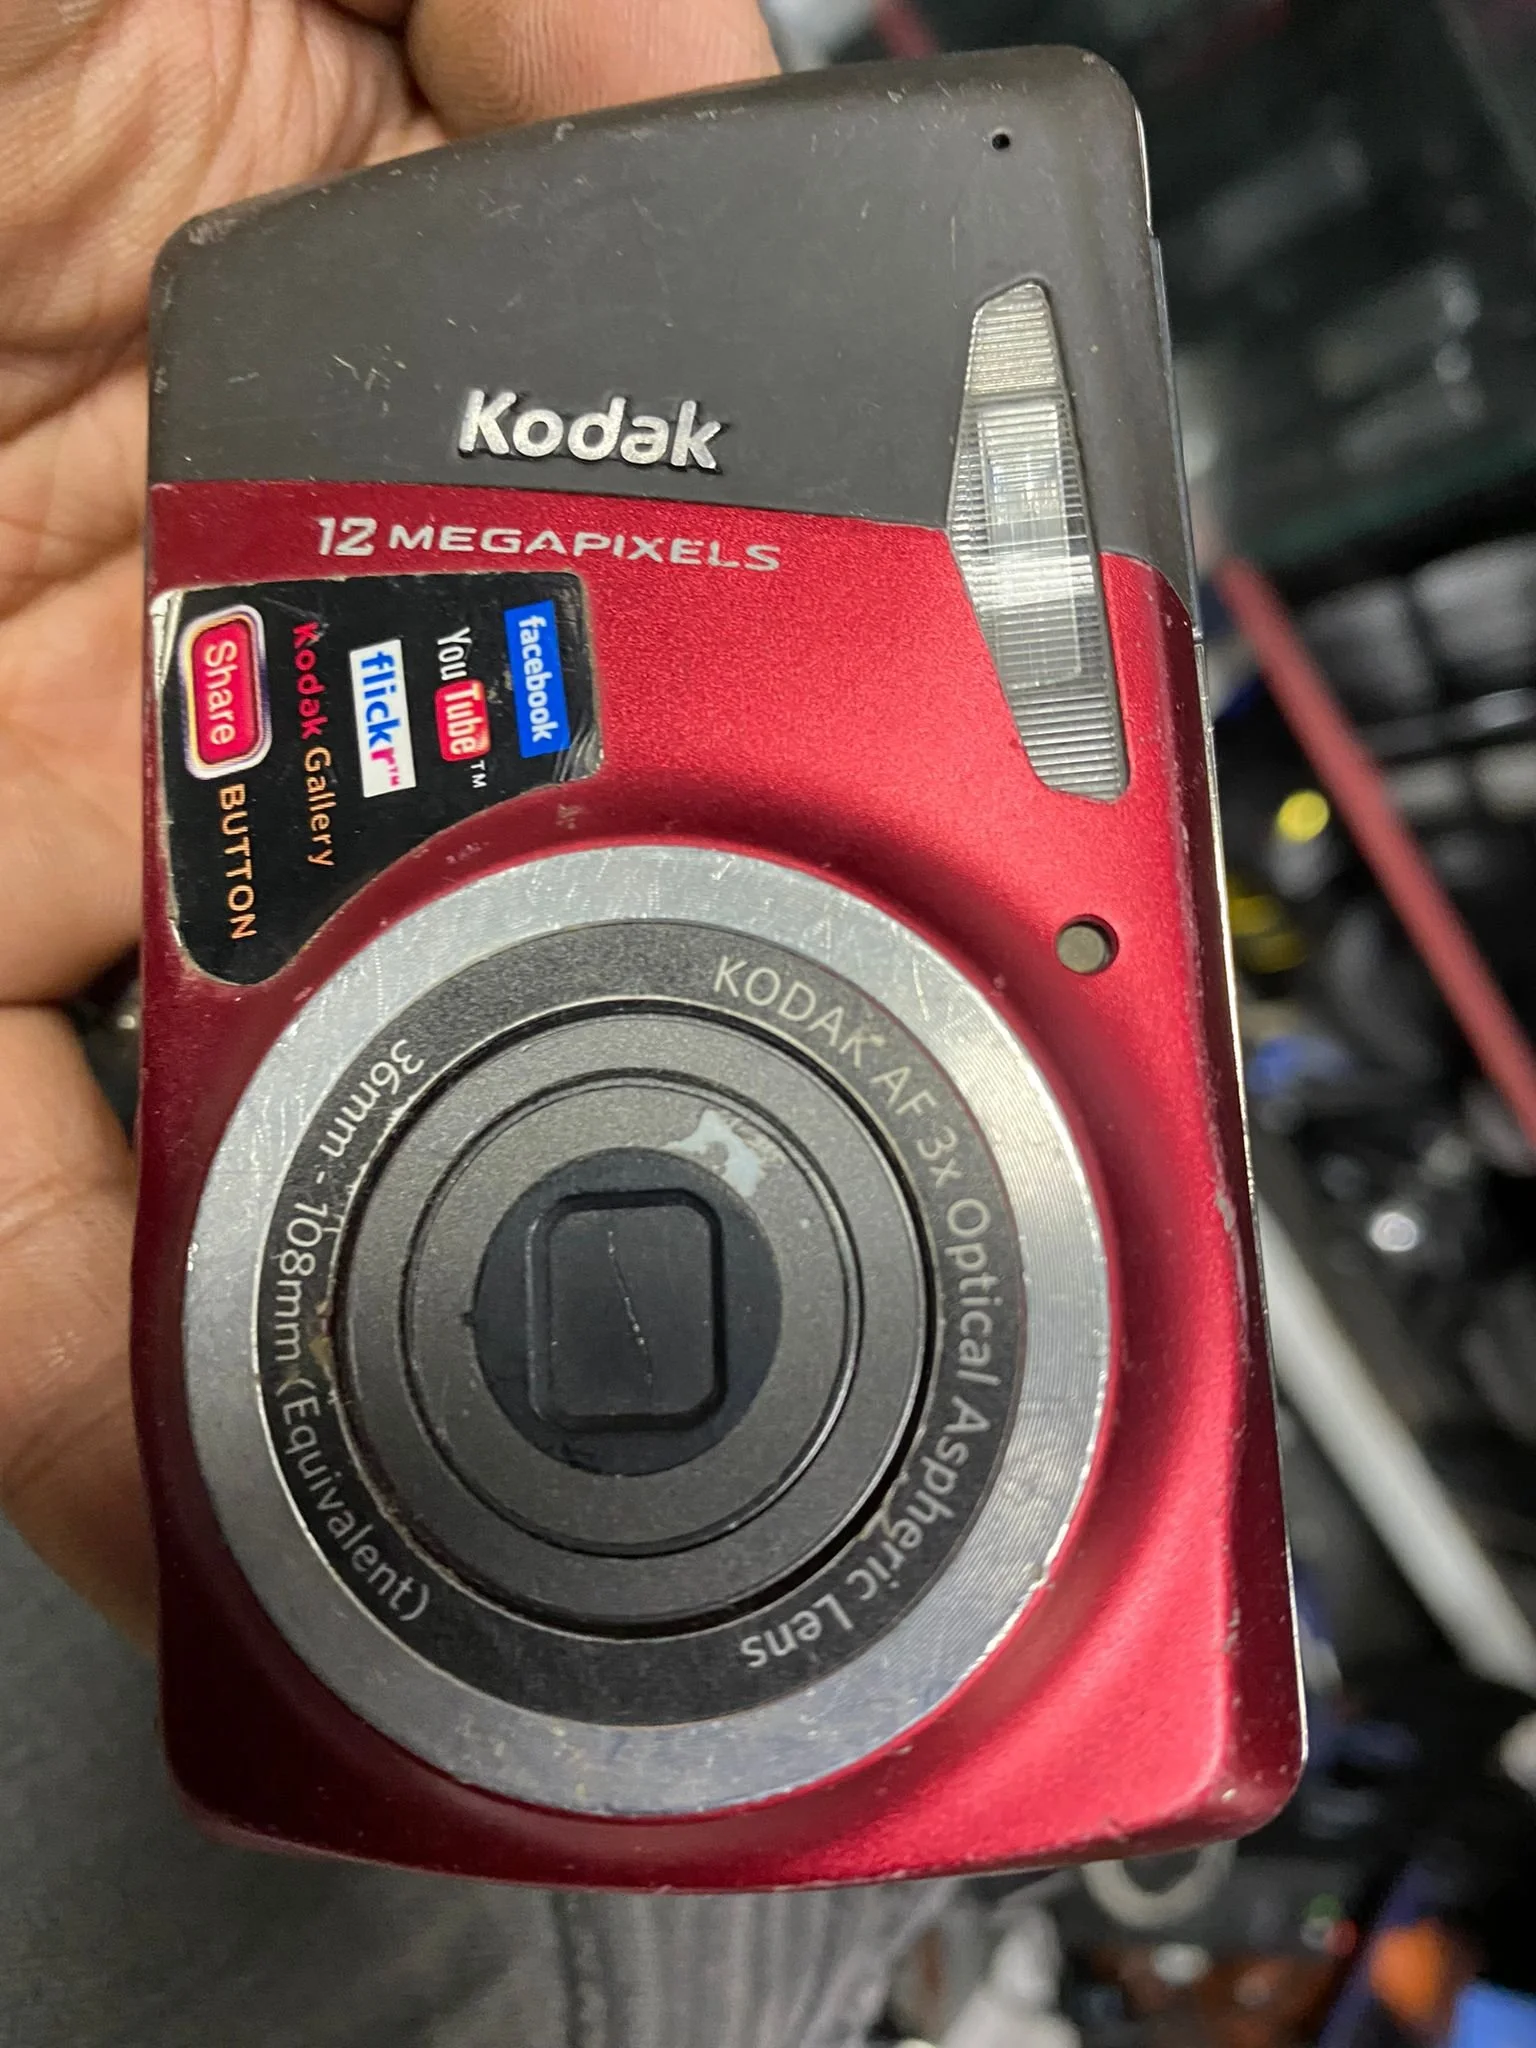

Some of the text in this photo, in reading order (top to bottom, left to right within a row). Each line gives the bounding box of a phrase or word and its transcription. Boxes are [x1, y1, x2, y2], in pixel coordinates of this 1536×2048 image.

[460, 388, 723, 469] Kodak
[317, 517, 780, 572] 12 MEGAPIXELS
[292, 622, 336, 867] Kodak Gallery
[518, 615, 559, 743] facebook
[204, 639, 257, 938] Share BUTTON
[320, 1039, 423, 1159] 36mm
[276, 1202, 328, 1362] 108mm
[714, 955, 1002, 1667] KODAK AF 3x Optical Aspheric Lens
[276, 1378, 429, 1622] (Equivalent)
